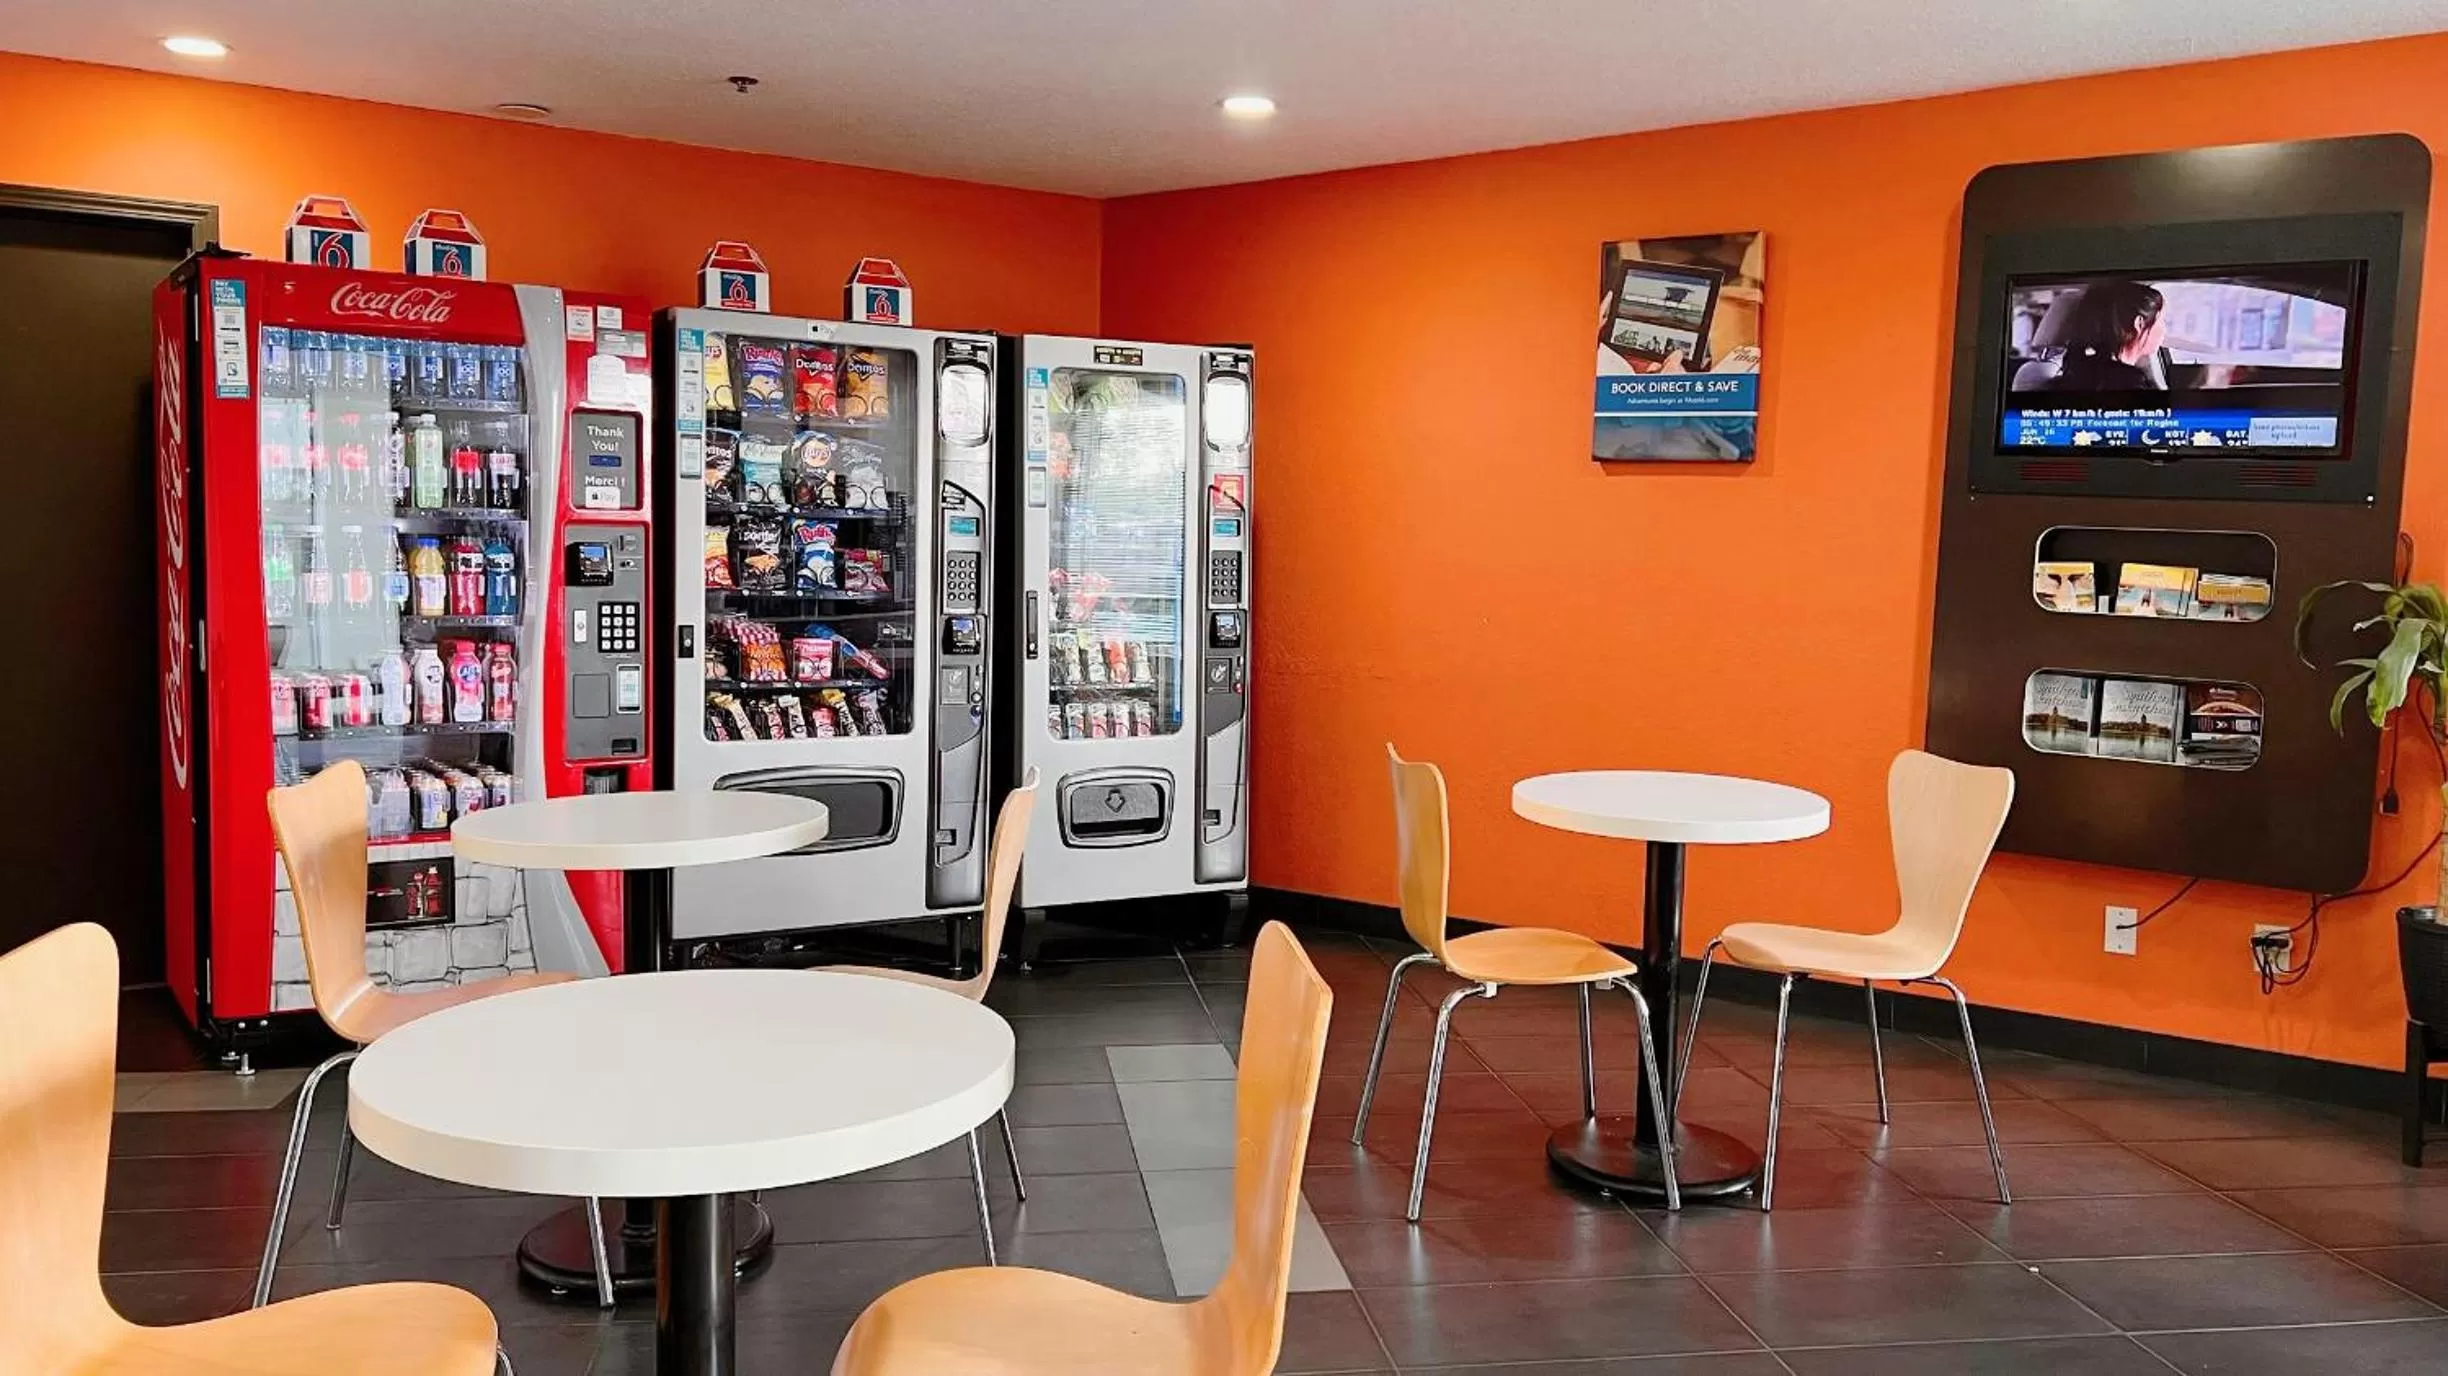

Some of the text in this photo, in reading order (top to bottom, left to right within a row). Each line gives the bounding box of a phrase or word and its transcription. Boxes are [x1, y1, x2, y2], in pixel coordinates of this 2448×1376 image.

[318, 232, 350, 269] 6
[442, 251, 463, 278] 6
[729, 280, 749, 301] 6
[331, 281, 458, 323] Coca-Cola
[874, 295, 893, 316] 6
[1611, 381, 1738, 394] BOOK DIRECT & SAVE
[2052, 408, 2062, 418] W
[2064, 409, 2071, 418] 7
[587, 425, 625, 438] Thank
[592, 441, 619, 452] You!
[585, 475, 618, 486] Merci
